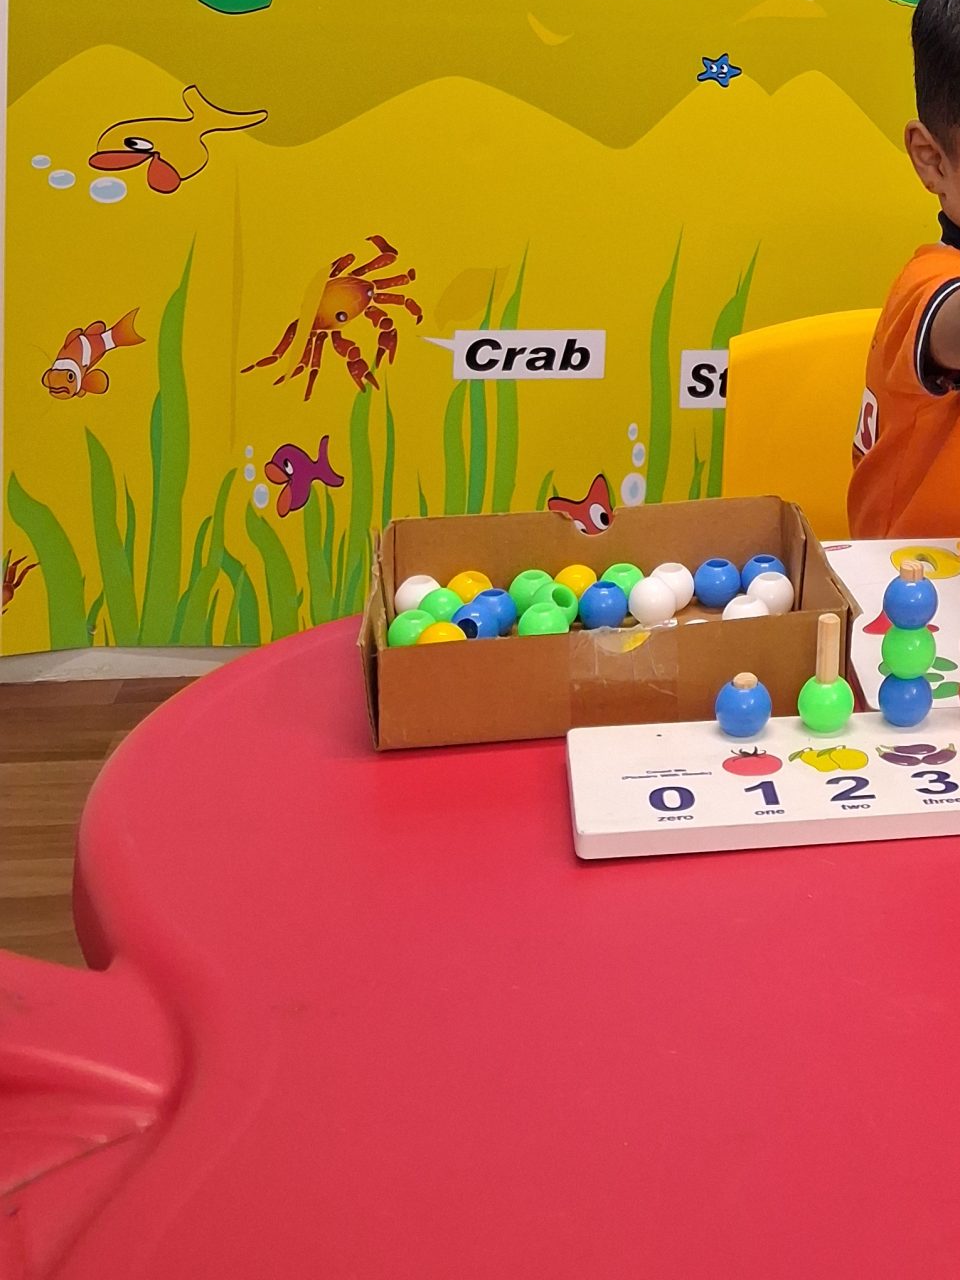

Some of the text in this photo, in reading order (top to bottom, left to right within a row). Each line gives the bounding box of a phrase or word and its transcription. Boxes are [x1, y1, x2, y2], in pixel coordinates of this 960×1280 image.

[465, 338, 591, 372] Crab
[687, 363, 728, 399] St
[648, 786, 695, 812] 0
[744, 780, 780, 806] 1
[825, 775, 877, 802] 2
[910, 770, 959, 795] 3
[657, 814, 694, 822] zero
[754, 808, 785, 816] one
[841, 802, 871, 811] two
